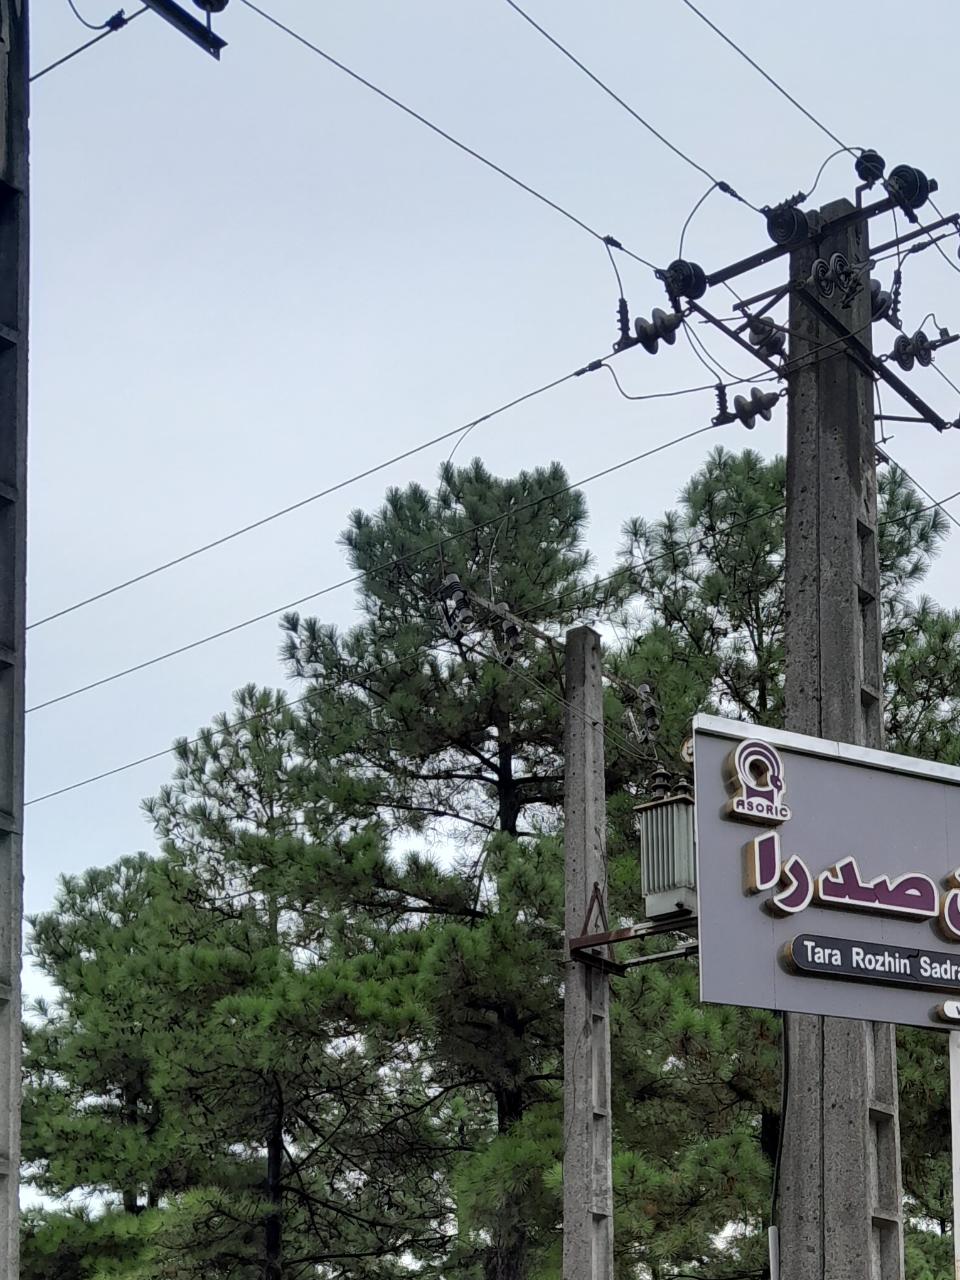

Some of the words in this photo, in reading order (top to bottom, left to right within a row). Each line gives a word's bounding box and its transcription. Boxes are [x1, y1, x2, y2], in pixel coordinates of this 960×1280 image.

[736, 799, 788, 817] ASORIC
[755, 832, 938, 915] صدرا
[803, 940, 842, 966] Tara
[852, 947, 911, 974] Rozhin
